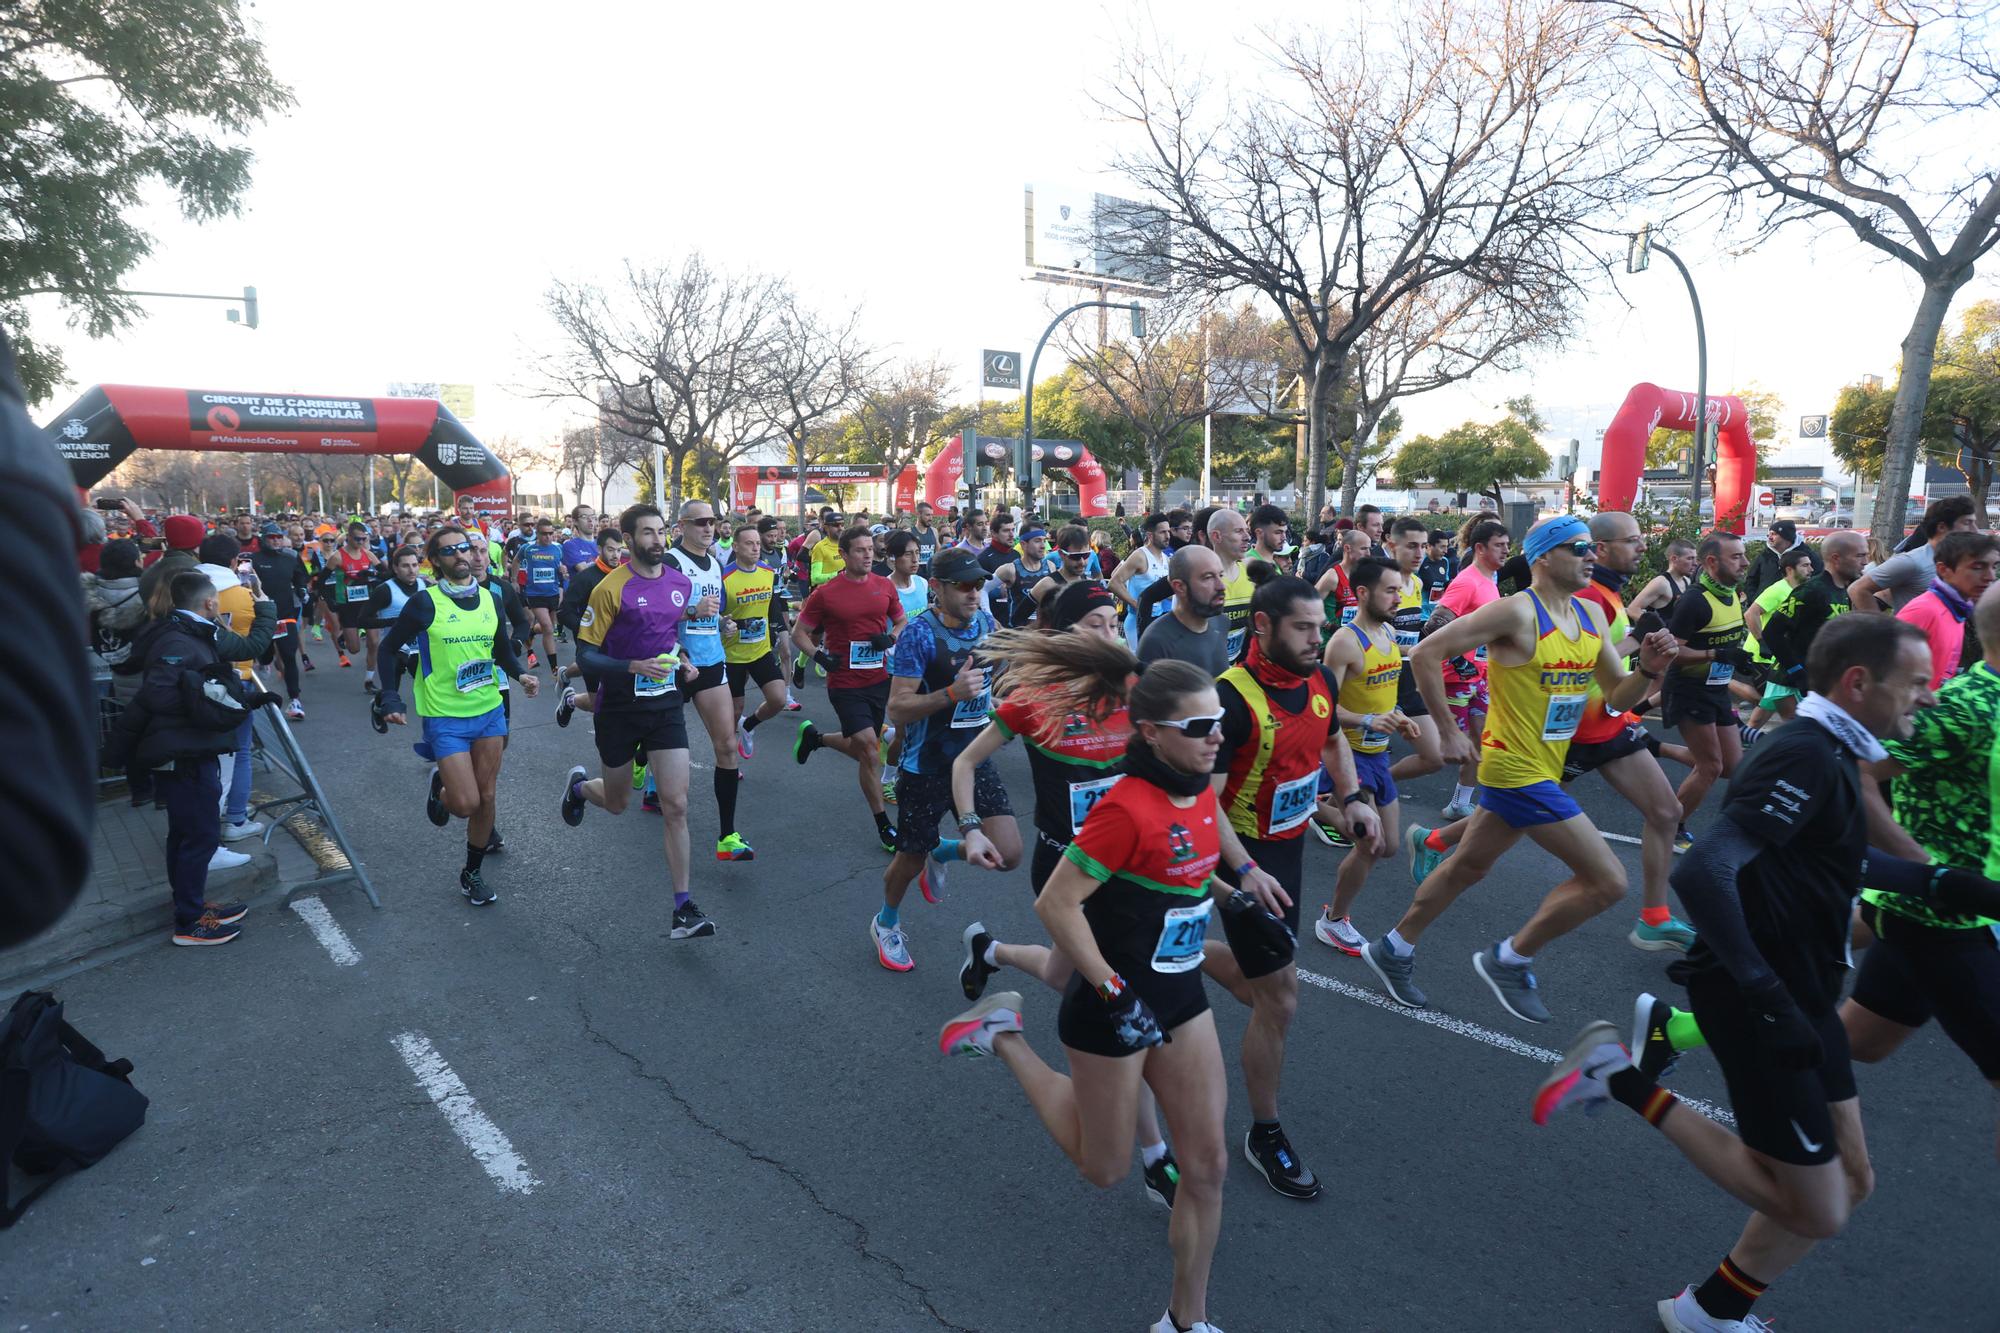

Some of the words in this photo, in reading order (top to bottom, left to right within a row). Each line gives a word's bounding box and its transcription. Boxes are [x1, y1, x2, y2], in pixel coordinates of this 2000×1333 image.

[986, 375, 1020, 384] LEXUS
[202, 394, 261, 406] CIRCUIT
[264, 398, 284, 407] DE
[286, 399, 361, 410] CARRERES
[209, 435, 298, 446] #ValènciaCorre
[461, 662, 486, 680] 2002
